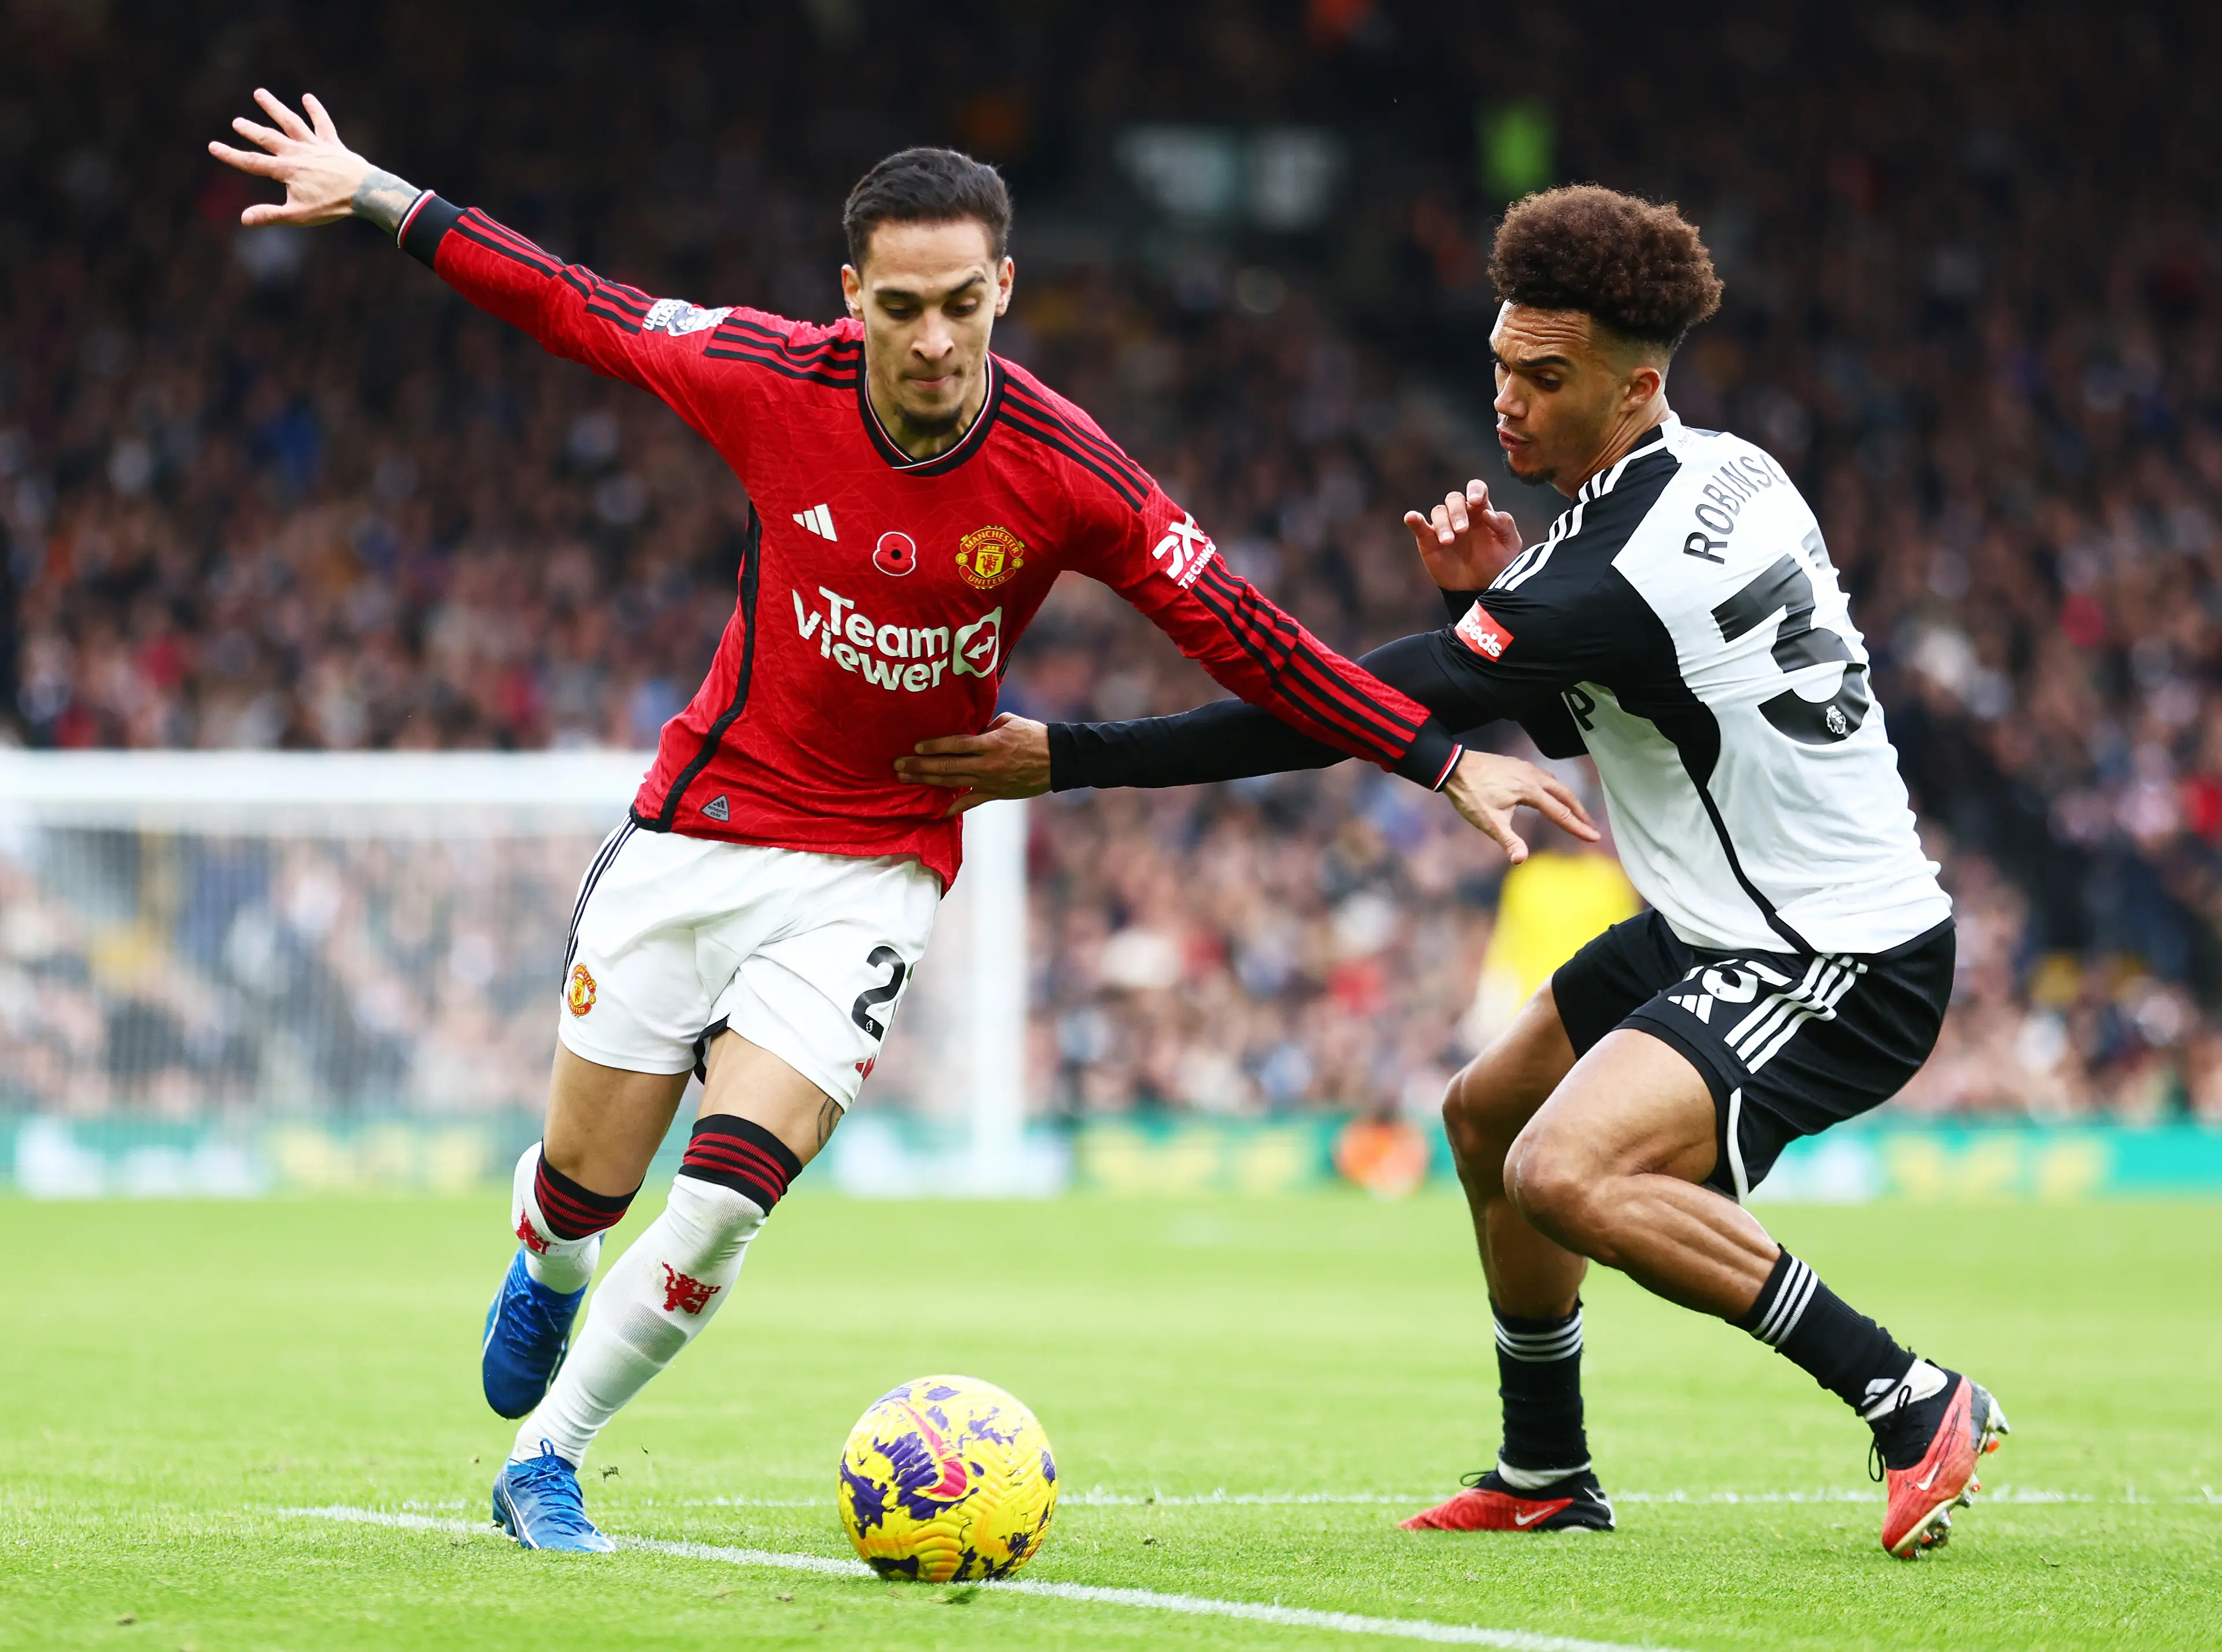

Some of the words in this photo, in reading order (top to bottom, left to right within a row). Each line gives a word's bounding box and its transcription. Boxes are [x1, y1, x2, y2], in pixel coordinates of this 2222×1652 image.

[964, 530, 1020, 554] MANCHESTER
[967, 575, 1005, 585] UNITED
[792, 588, 948, 692] Viewer
[818, 586, 950, 658] Team
[1710, 527, 1870, 745] 3
